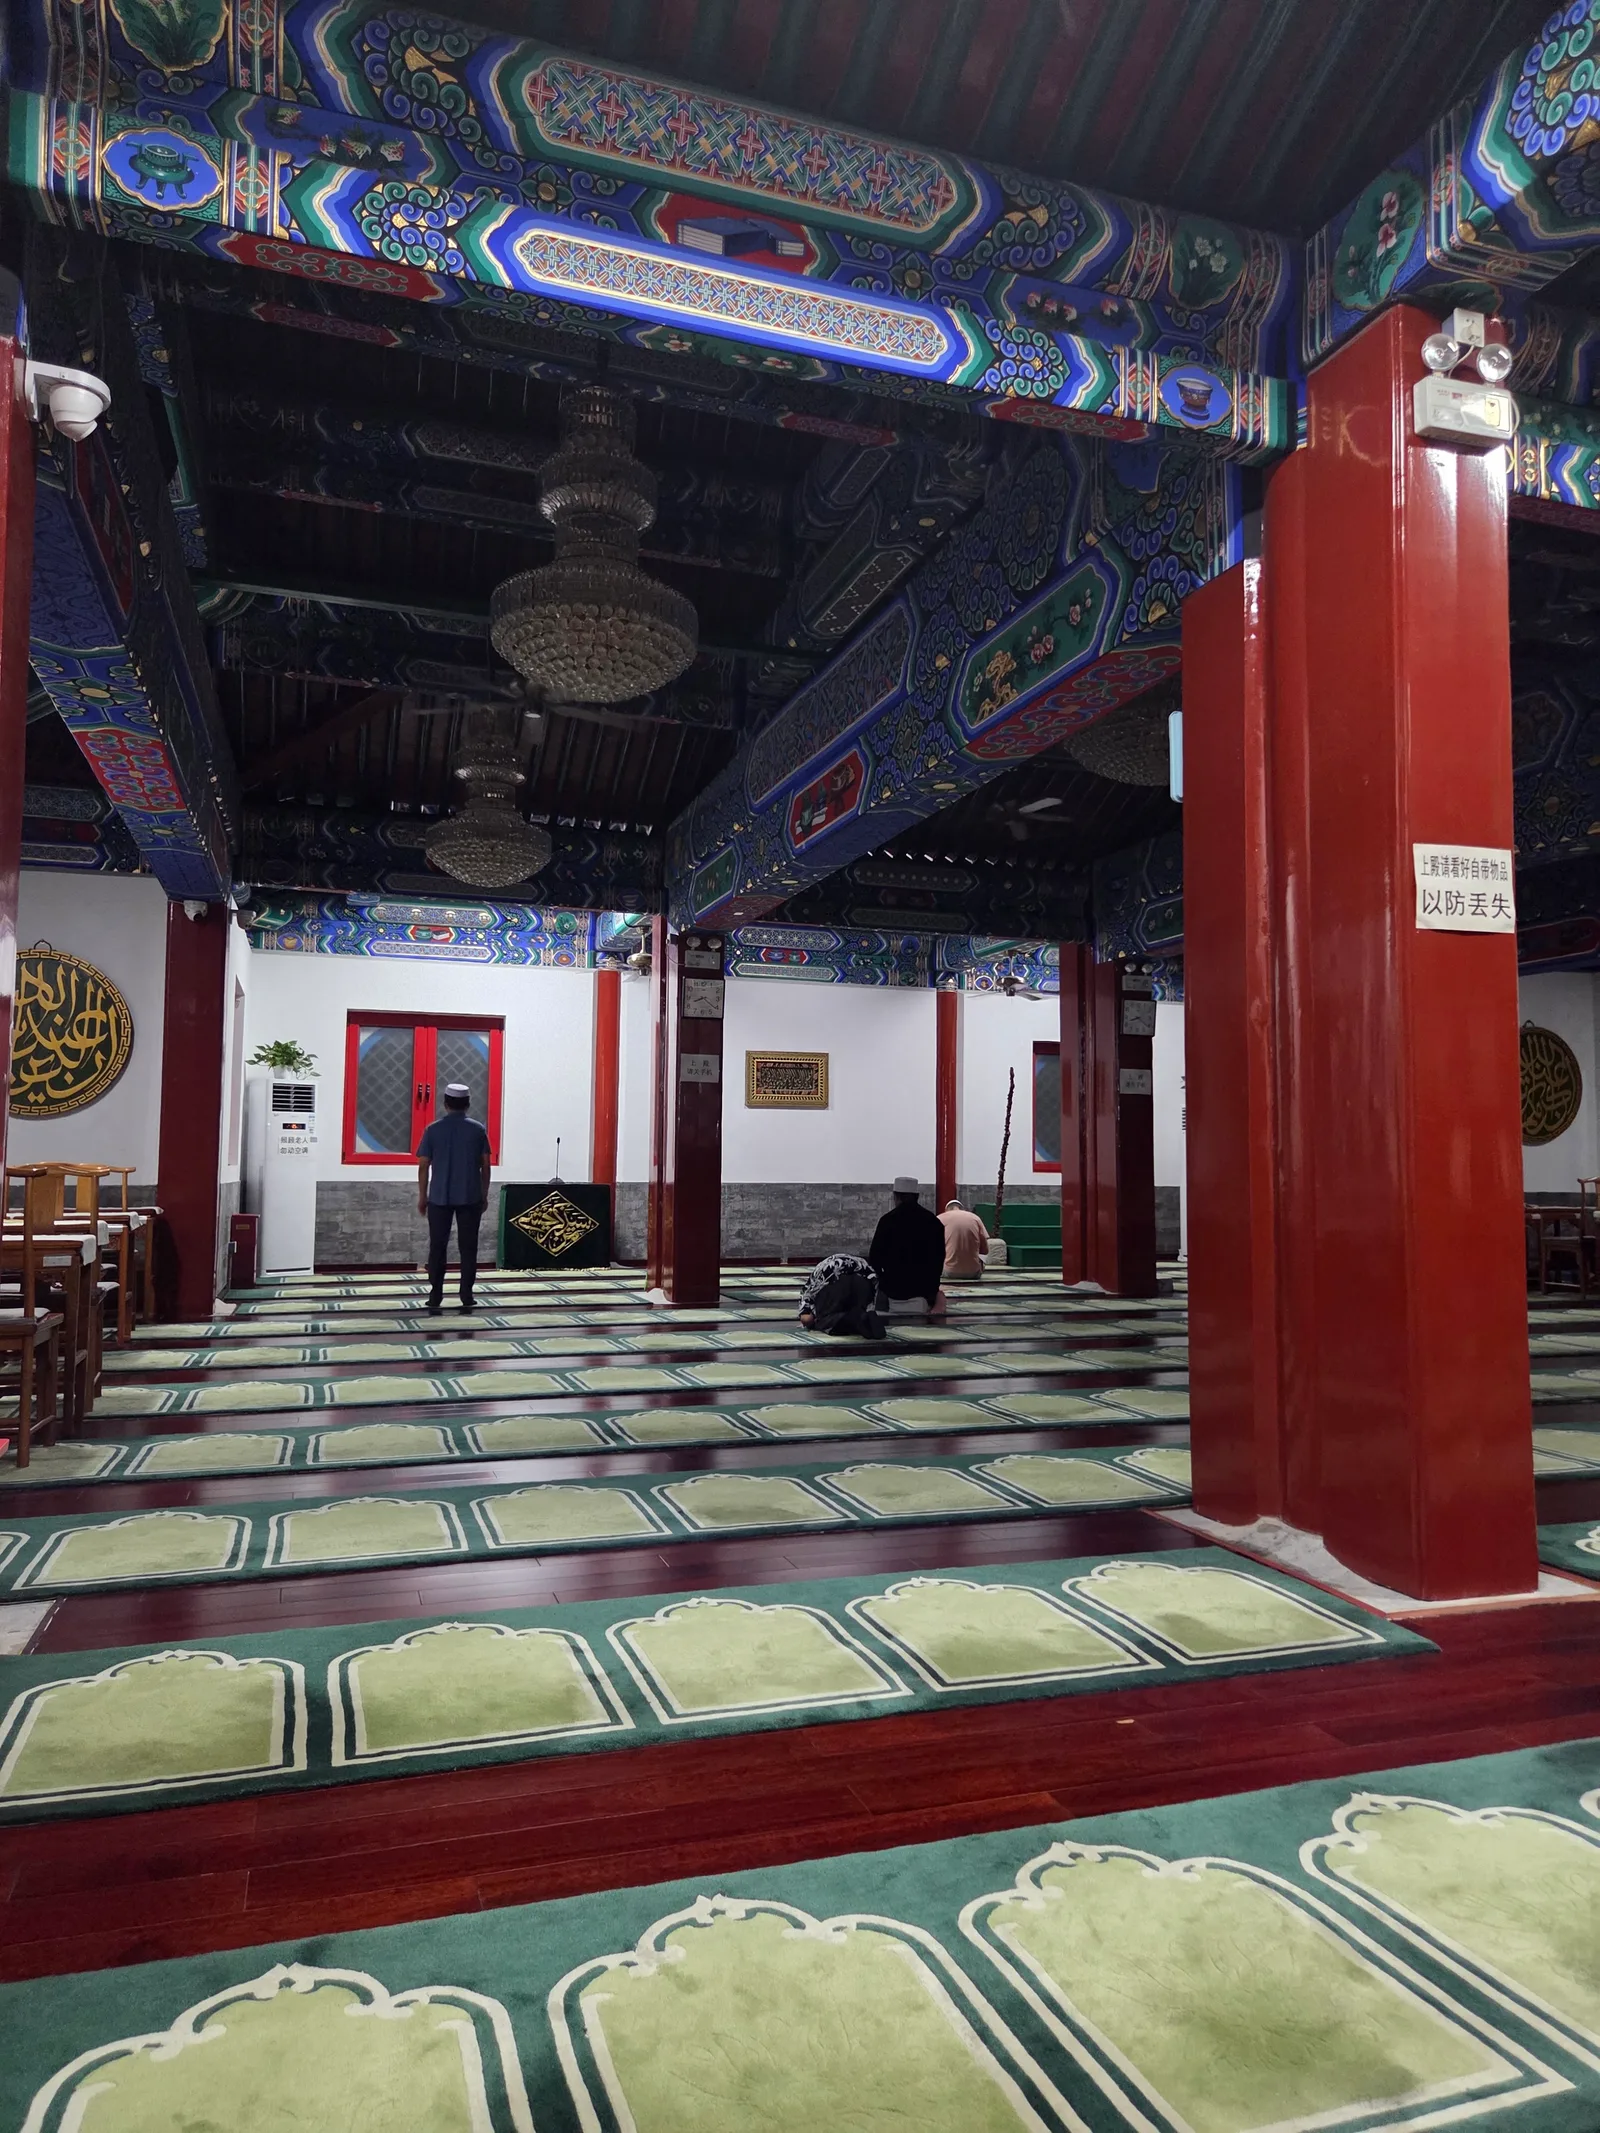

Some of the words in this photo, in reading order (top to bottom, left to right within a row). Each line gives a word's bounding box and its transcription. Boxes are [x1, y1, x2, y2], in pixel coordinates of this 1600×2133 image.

[1420, 855, 1508, 882] 上殿请看好自带物品
[1422, 889, 1512, 919] 以防丢失
[280, 1147, 309, 1155] 勿动空调
